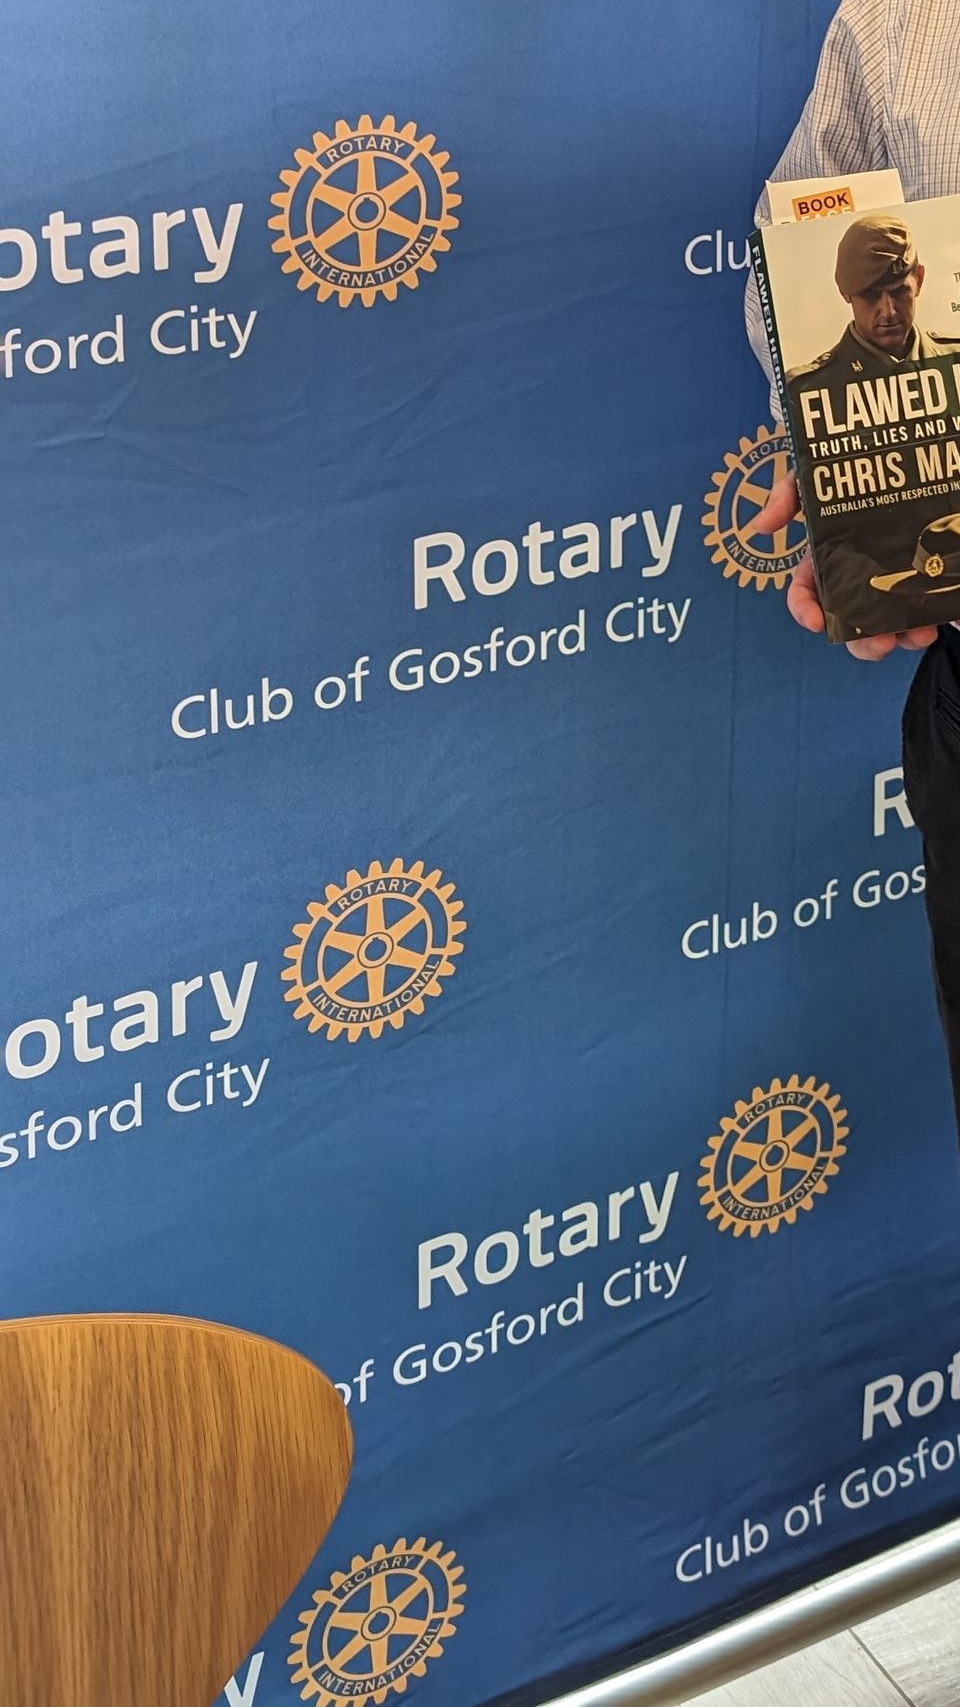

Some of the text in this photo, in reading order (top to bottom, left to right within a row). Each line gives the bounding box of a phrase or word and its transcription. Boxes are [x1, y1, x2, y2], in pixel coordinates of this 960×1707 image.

[327, 136, 404, 162] ROTARY
[798, 192, 850, 215] BOOK
[0, 202, 244, 292] otary
[301, 234, 433, 287] INTERNATIONAL
[684, 229, 751, 275] Clu
[752, 245, 774, 333] FLAWED
[0, 304, 258, 379] ford City
[799, 368, 948, 439] FLAWED
[749, 439, 791, 463] ROTA
[809, 434, 869, 458] TRUTH,
[873, 426, 908, 447] LIES
[915, 419, 947, 439] AND
[813, 451, 907, 502] CHRIS
[820, 497, 874, 517] AUSTRALIA'S
[876, 492, 900, 506] MOST
[901, 483, 949, 501] RESPECTED
[413, 503, 683, 611] Rotary
[171, 596, 691, 739] Club of Gosford City
[337, 878, 414, 910] ROTARY
[681, 901, 778, 959] Club
[793, 878, 838, 927] of
[4, 960, 259, 1080] otary
[311, 959, 439, 1023] INTERNATIONAL
[0, 1057, 271, 1169] sford City
[743, 1093, 805, 1123] ROTARY
[723, 1165, 824, 1220] INTERNATIONAL
[418, 1171, 679, 1310] Rotary
[392, 1281, 584, 1386] Gosford
[603, 1255, 687, 1307] City
[675, 1518, 769, 1582] Club
[784, 1483, 826, 1536] of
[342, 1555, 415, 1591] ROTARY
[318, 1620, 440, 1696] INTERNATIONAL
